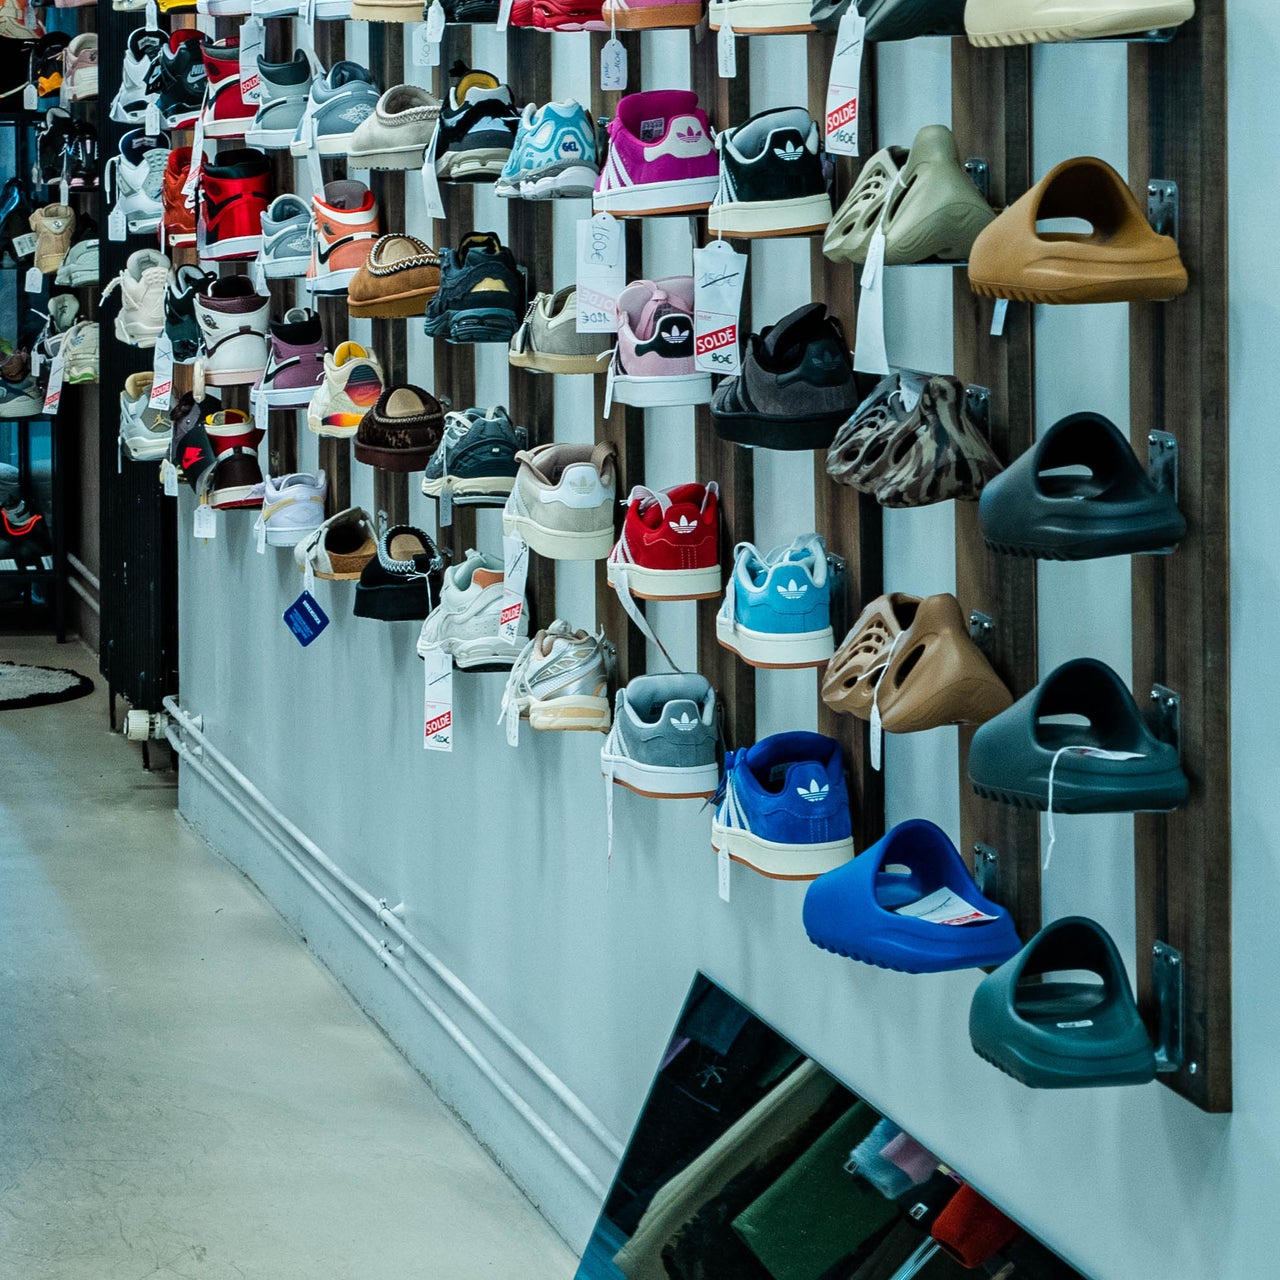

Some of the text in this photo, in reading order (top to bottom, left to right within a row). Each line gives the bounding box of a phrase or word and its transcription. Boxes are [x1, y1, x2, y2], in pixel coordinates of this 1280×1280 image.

[828, 103, 856, 131] SOLDÉ
[562, 141, 579, 152] GEL
[696, 327, 736, 352] SOLDÉ
